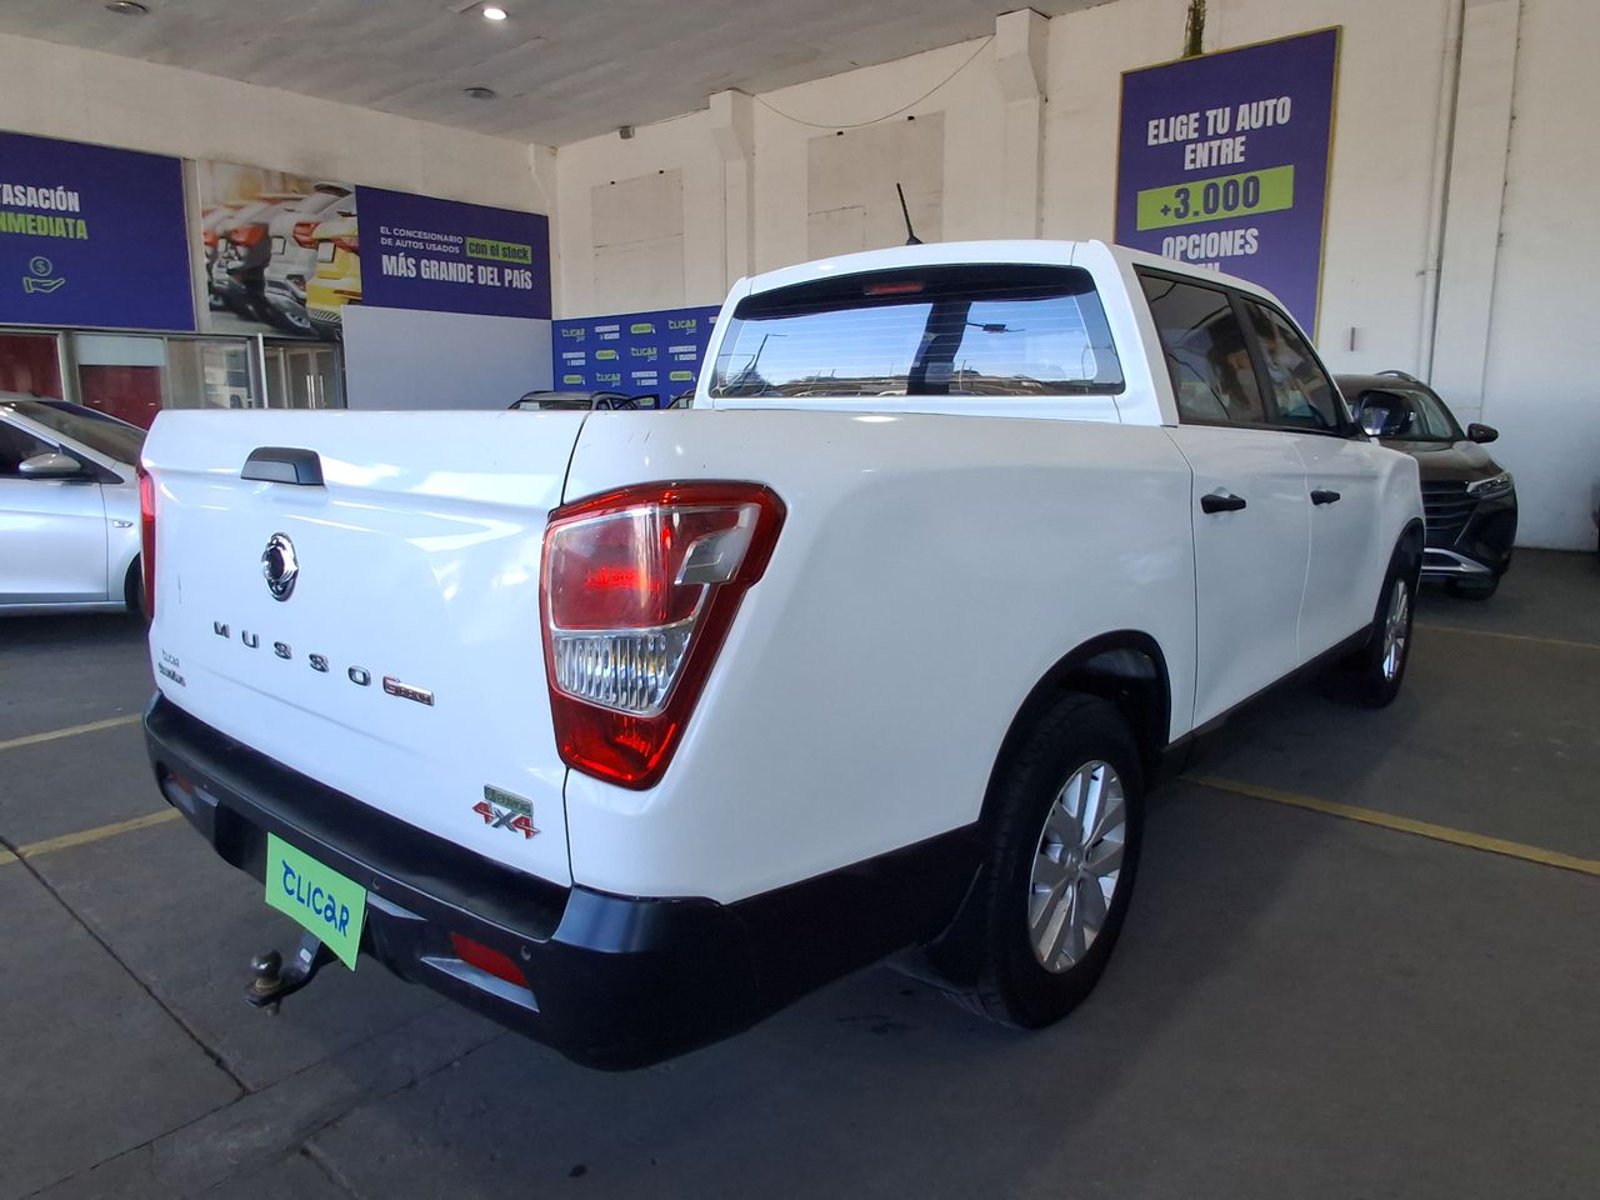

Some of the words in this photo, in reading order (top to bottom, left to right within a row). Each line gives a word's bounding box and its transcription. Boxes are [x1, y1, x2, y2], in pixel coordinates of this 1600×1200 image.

[1148, 111, 1199, 146] ELIGE
[1206, 106, 1231, 137] TU
[1236, 96, 1292, 132] AUTO
[1184, 135, 1247, 171] ENTRE
[0, 183, 81, 213] ASACIÓN
[1160, 175, 1261, 220] +3.000
[380, 226, 391, 235] EL
[393, 228, 464, 244] CONCESIONARIO
[380, 237, 393, 246] DE
[395, 239, 424, 250] AUTOS
[425, 243, 460, 254] USADOS
[1162, 228, 1259, 261] OPCIONES
[381, 252, 417, 278] MÁS
[420, 258, 475, 284] GRANDE
[477, 264, 501, 287] DEL
[504, 268, 534, 290] PAÍS
[213, 620, 372, 687] MUSSO
